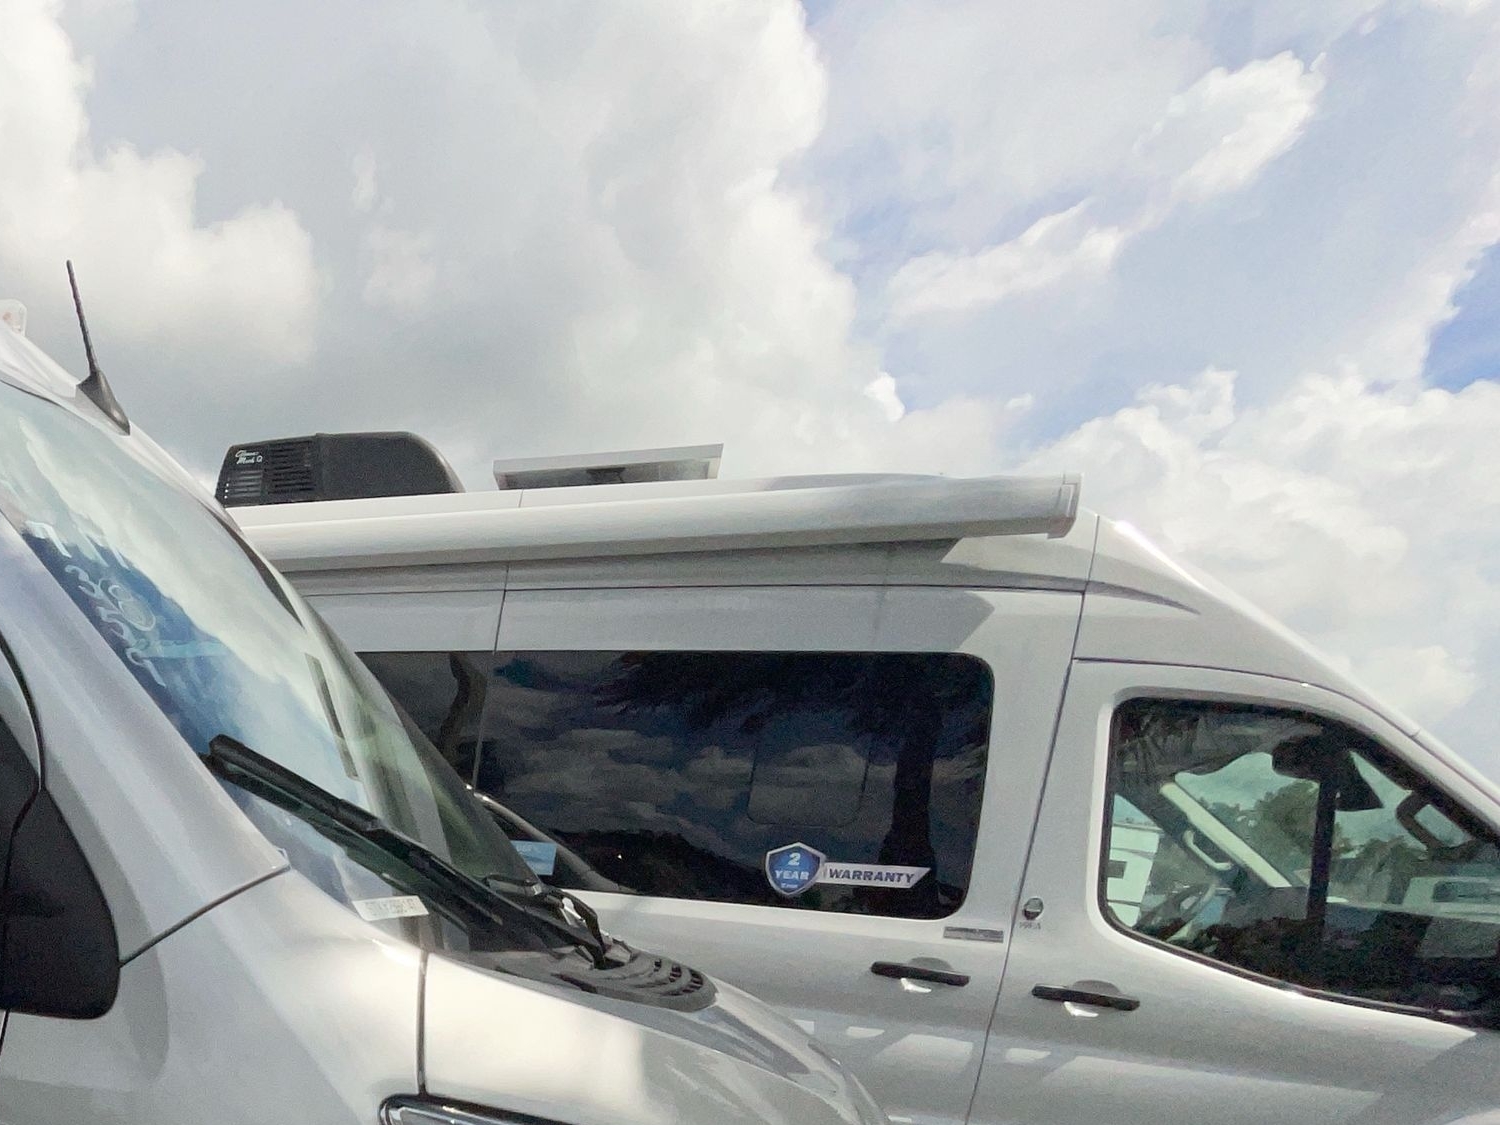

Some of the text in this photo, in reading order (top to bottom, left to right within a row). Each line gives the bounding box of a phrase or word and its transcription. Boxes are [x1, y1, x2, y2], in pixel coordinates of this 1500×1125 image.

[787, 852, 801, 866] 2
[774, 869, 810, 881] YEAR
[828, 868, 916, 883] WARRANTY
